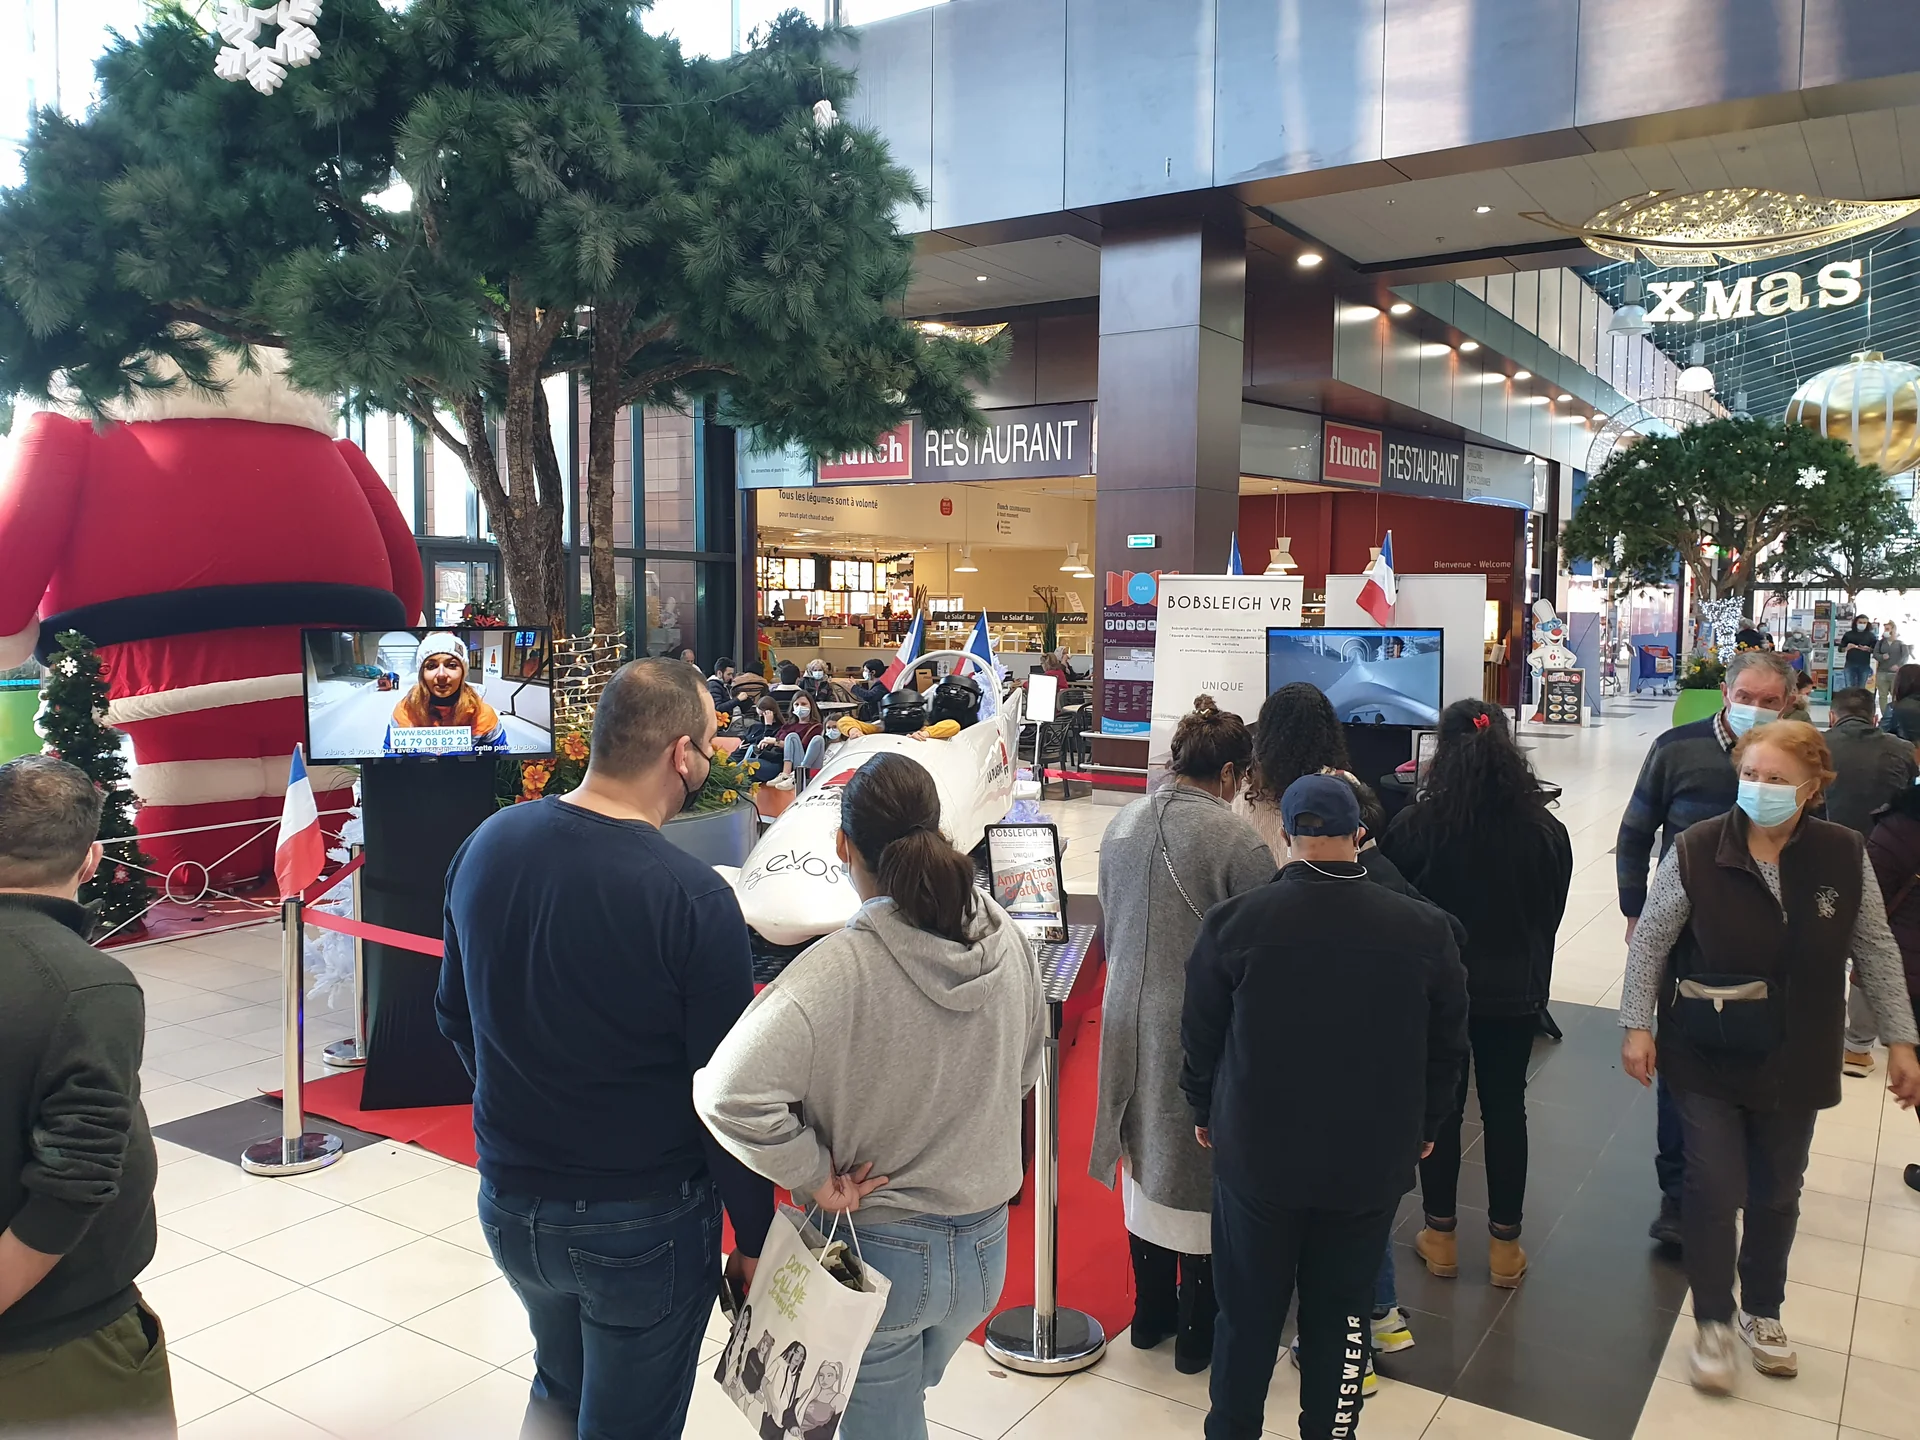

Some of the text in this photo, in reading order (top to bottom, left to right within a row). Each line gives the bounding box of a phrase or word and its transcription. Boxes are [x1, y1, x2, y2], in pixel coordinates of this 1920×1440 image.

[826, 435, 904, 466] unch
[1328, 435, 1459, 487] flunch RESTAURANT
[779, 489, 878, 509] Tous les légumes sont à volonté
[1434, 560, 1471, 569] Bienvenue
[1479, 560, 1511, 568] Welcome
[1032, 584, 1059, 593] Service
[1167, 595, 1292, 611] BOBSLEIGH VR
[1300, 616, 1312, 624] Bar
[1202, 681, 1244, 692] UNIQUE
[392, 728, 470, 737] WWW.BOBSLEIGH.NET
[393, 736, 470, 746] 04 79 08 82 23
[494, 744, 510, 752] piste
[806, 794, 842, 803] PLA
[997, 866, 1056, 887] Animation
[1004, 881, 1054, 900] Gratuite
[784, 1253, 811, 1286] DON'T
[772, 1267, 808, 1306] CALL ME
[1330, 1315, 1363, 1440] ORTSWEAR
